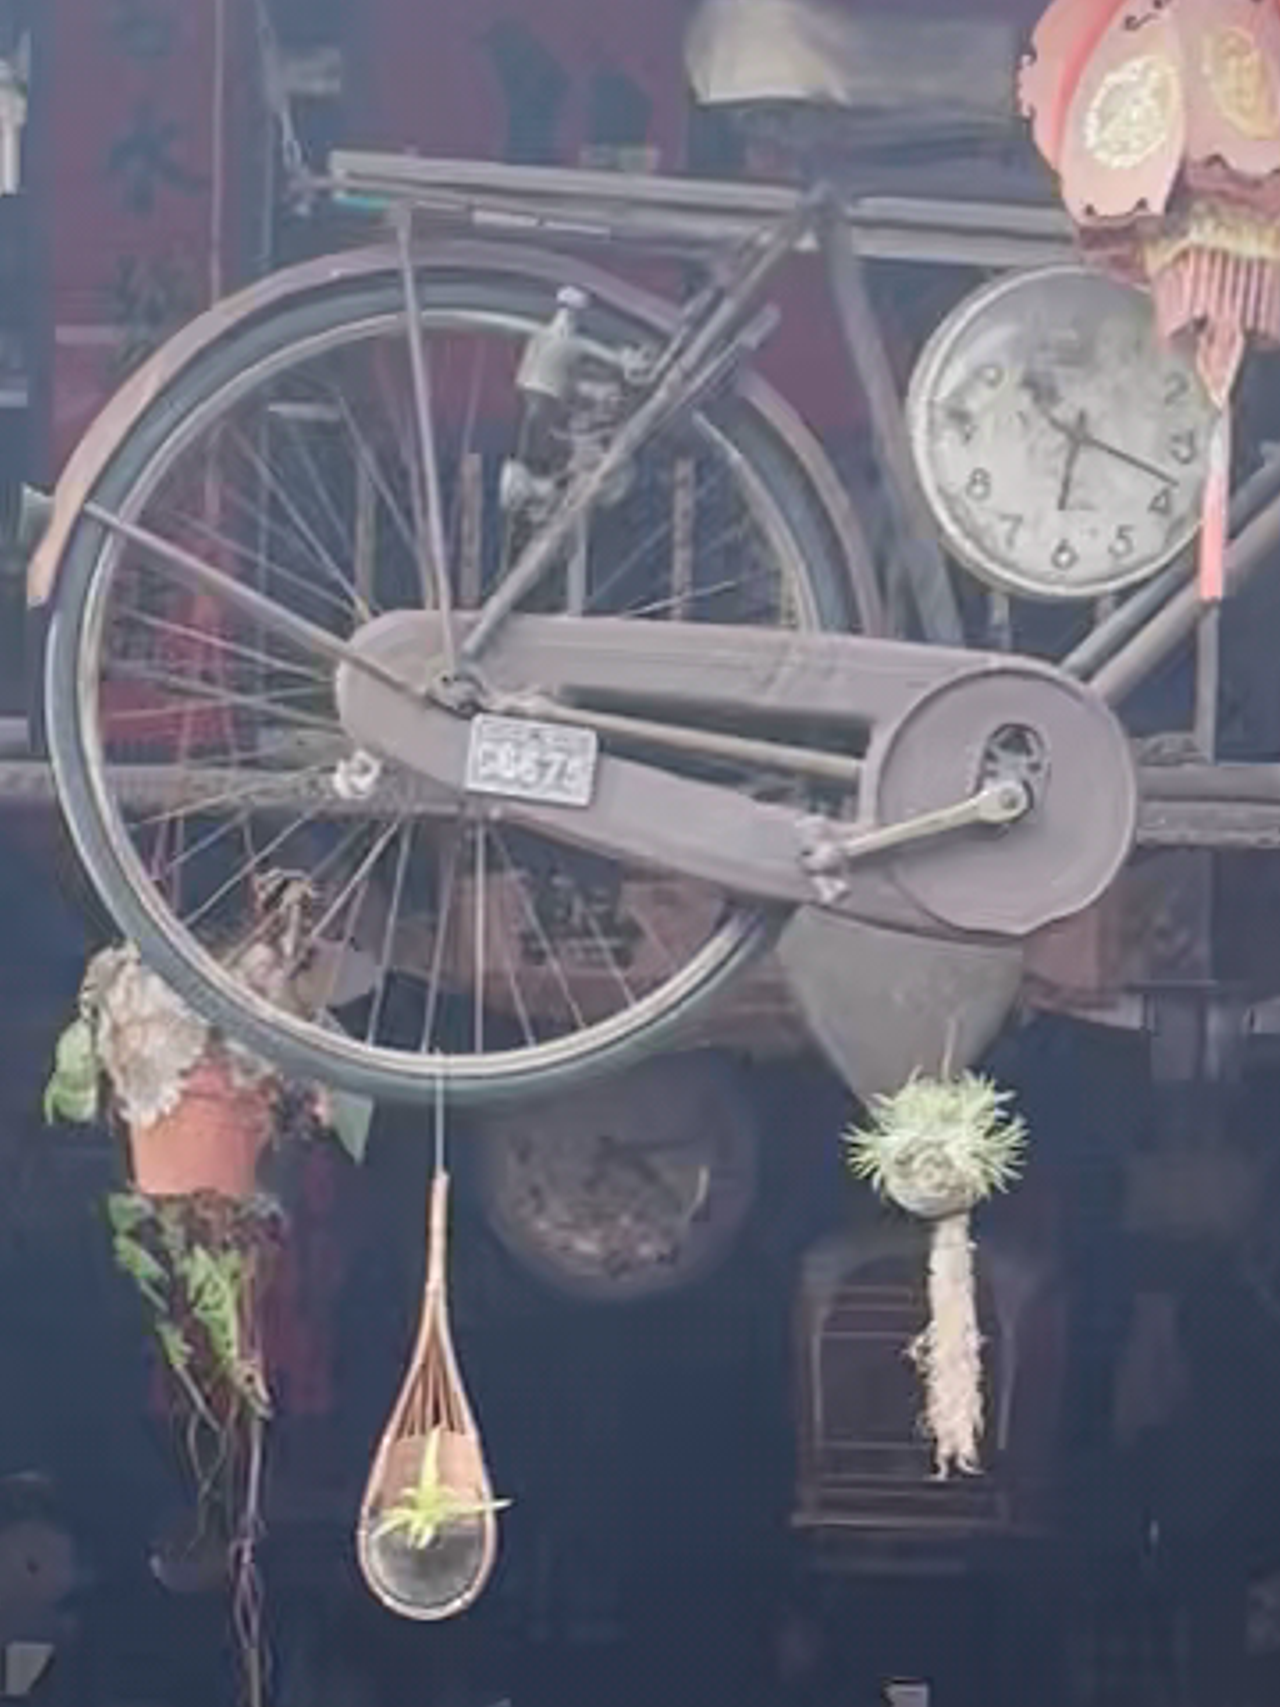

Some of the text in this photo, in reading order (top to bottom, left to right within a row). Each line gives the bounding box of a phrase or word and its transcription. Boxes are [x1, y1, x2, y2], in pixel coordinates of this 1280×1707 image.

[966, 468, 991, 501] 8
[1000, 514, 1023, 549] 7
[1108, 524, 1134, 558] 5
[1051, 538, 1078, 571] 6
